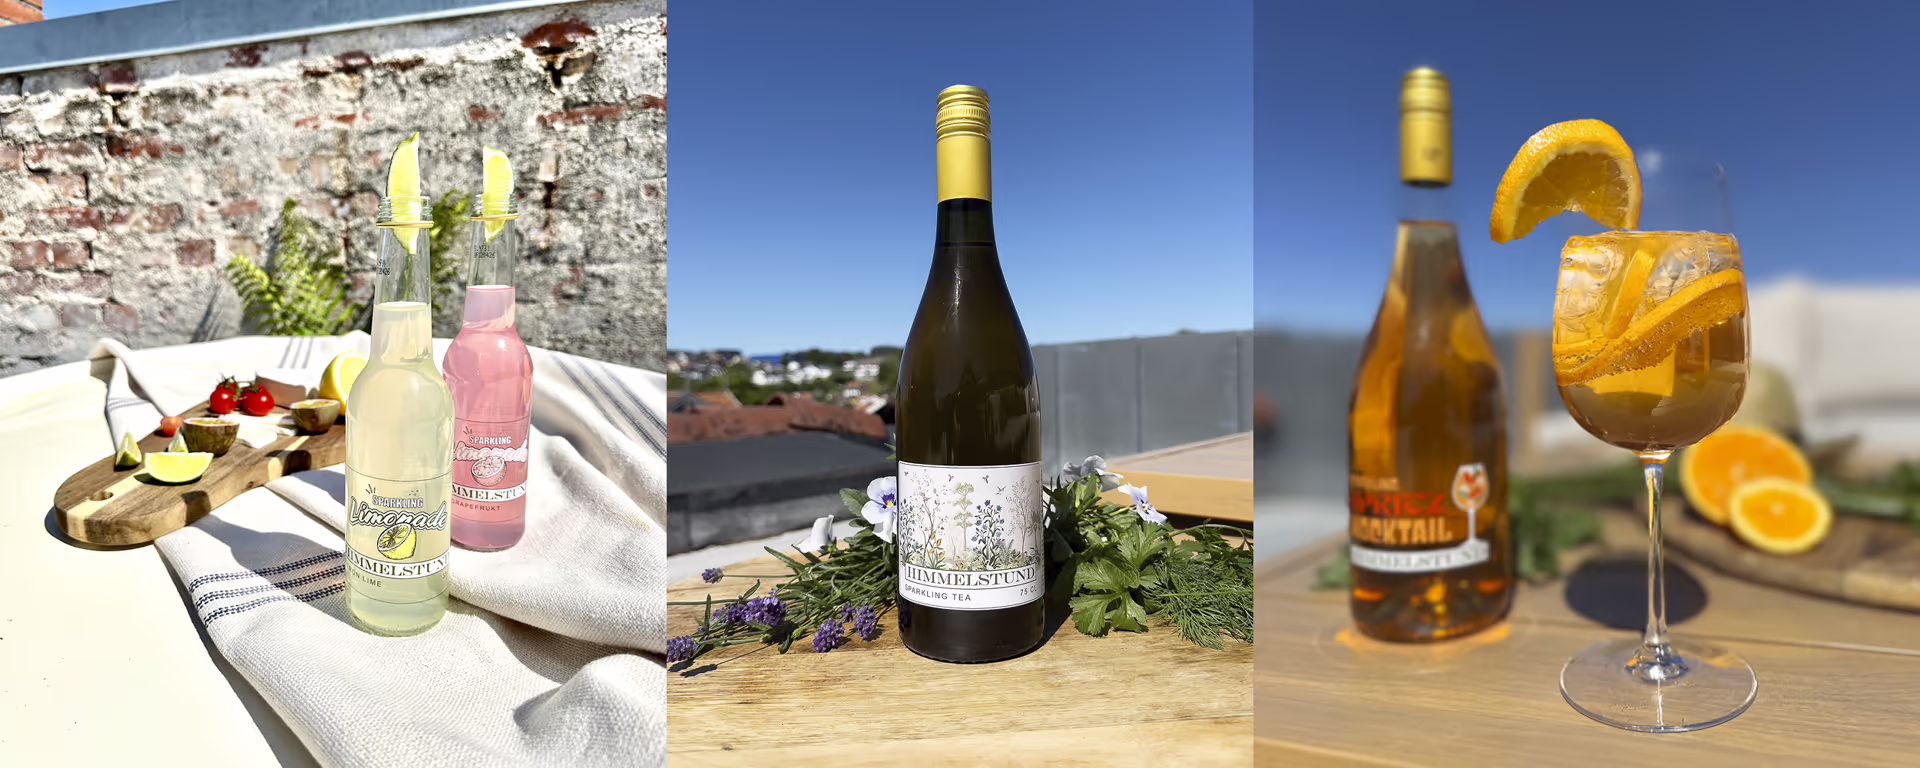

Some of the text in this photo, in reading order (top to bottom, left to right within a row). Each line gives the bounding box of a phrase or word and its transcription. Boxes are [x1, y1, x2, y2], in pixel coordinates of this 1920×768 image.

[469, 435, 512, 445] SPARKLING
[453, 439, 528, 462] imonade
[372, 494, 424, 508] SPARKLING
[452, 484, 527, 500] MMELSTUN
[349, 496, 448, 531] Limonade
[346, 563, 382, 587] MON LIME
[907, 566, 1035, 586] HIMMELSTUND
[904, 584, 948, 600] SPARKLING
[952, 593, 972, 601] TEA
[1020, 588, 1028, 596] 75
